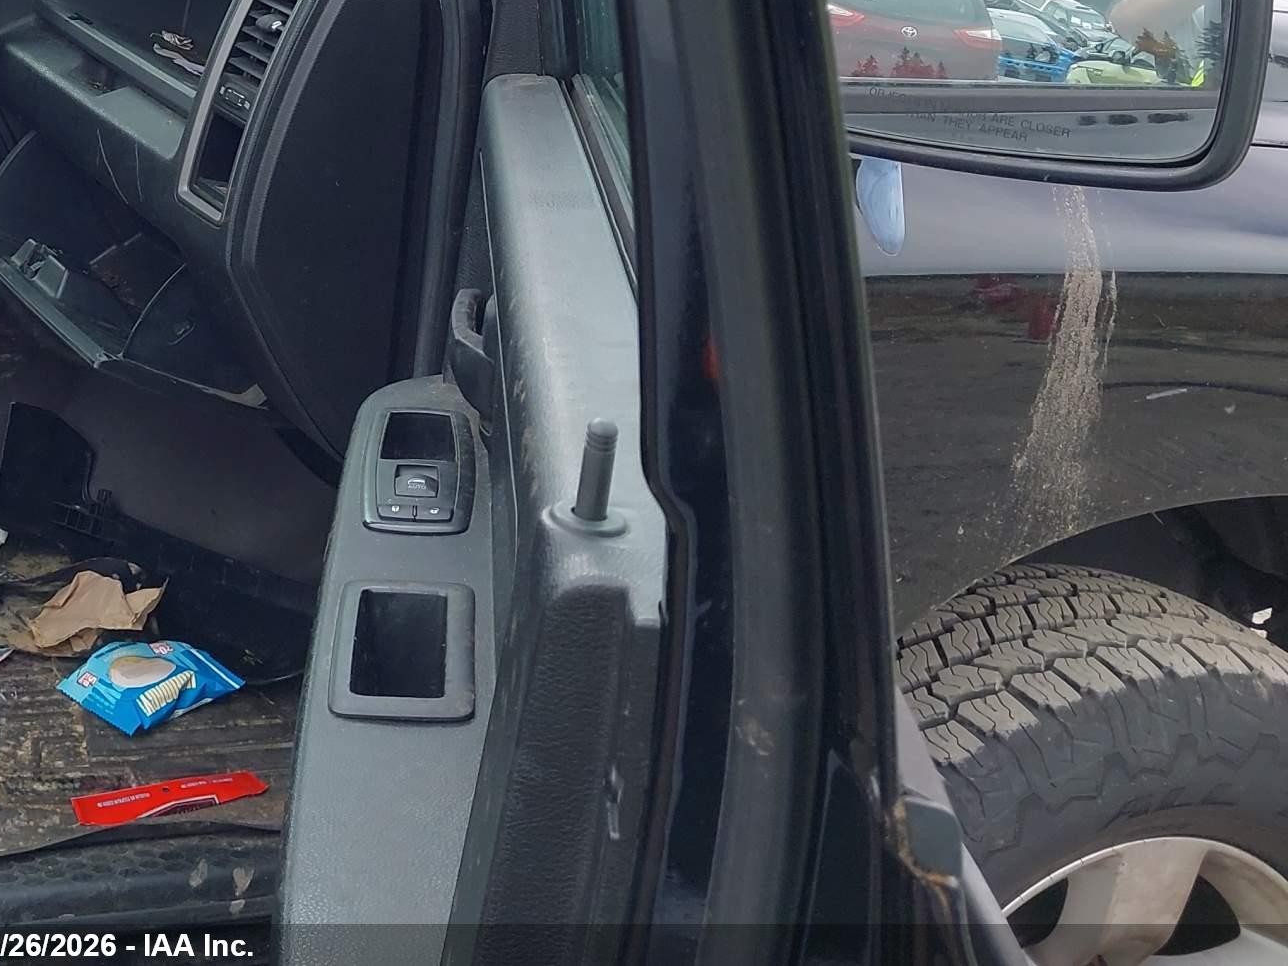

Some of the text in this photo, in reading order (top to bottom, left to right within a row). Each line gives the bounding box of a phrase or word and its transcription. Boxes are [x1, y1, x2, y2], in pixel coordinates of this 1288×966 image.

[979, 123, 1029, 142] APPEAR
[992, 113, 1016, 127] ARE
[1020, 119, 1072, 139] CLOSER
